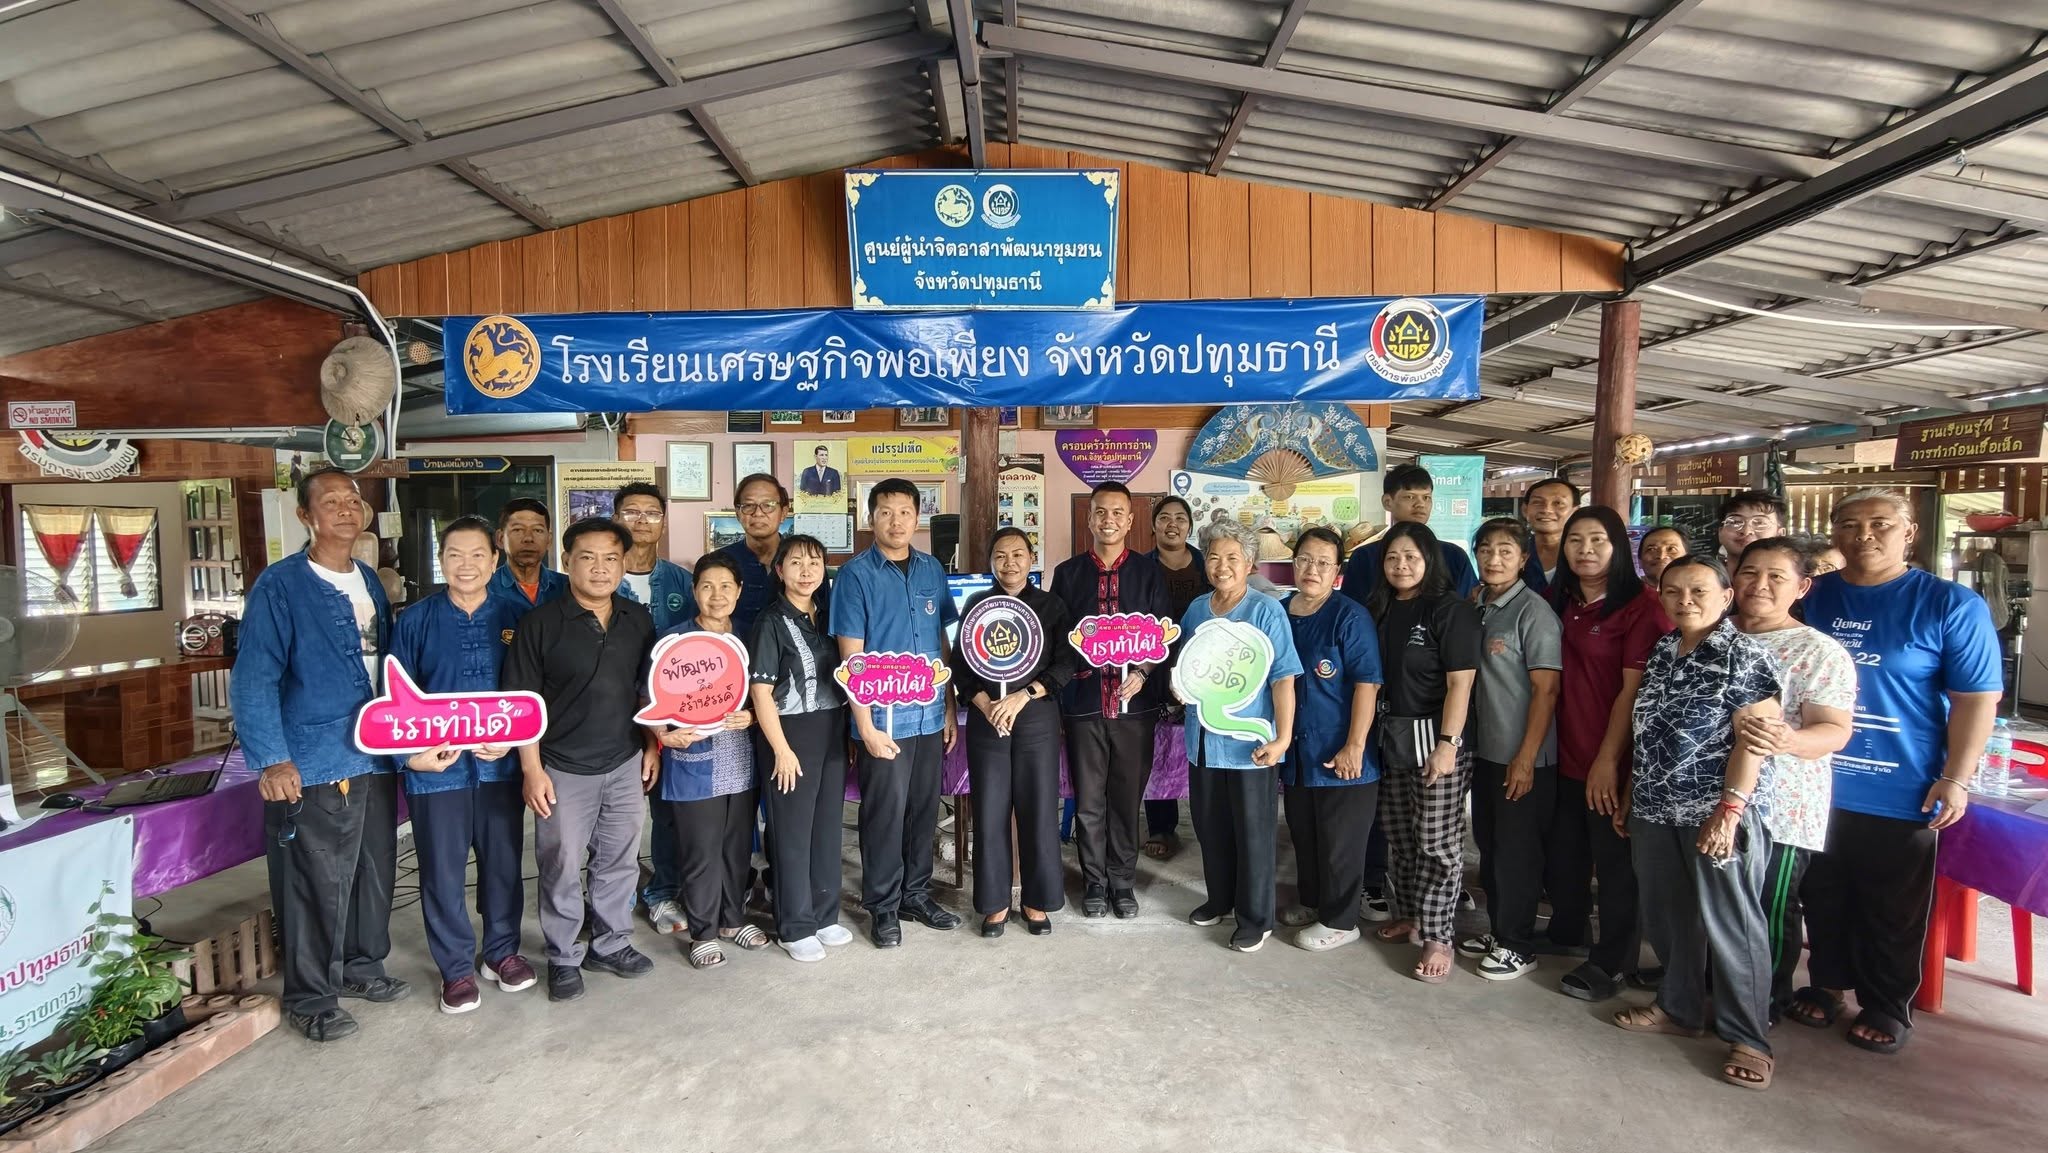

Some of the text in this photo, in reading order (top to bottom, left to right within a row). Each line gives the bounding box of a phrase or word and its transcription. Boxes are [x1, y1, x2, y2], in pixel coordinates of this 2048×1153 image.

[863, 235, 1103, 264] ศูนย์ผู้นำจิตอาสาพัฒนาชุมชน
[914, 271, 1042, 296] จังหวัดปทุมธานี
[551, 322, 1341, 391] โรงเรียนเศรษฐกิจพอเพียง จังหวัดปทุมธานี
[1368, 351, 1451, 383] กรมการพัฒนาชุมชน
[29, 415, 72, 424] NO SMOKING
[2002, 416, 2010, 430] 1
[872, 441, 922, 457] แปรรูปเห็ด
[1062, 438, 1152, 451] ครอบครัวรักการอ่าน
[662, 656, 724, 681] พัฒนา
